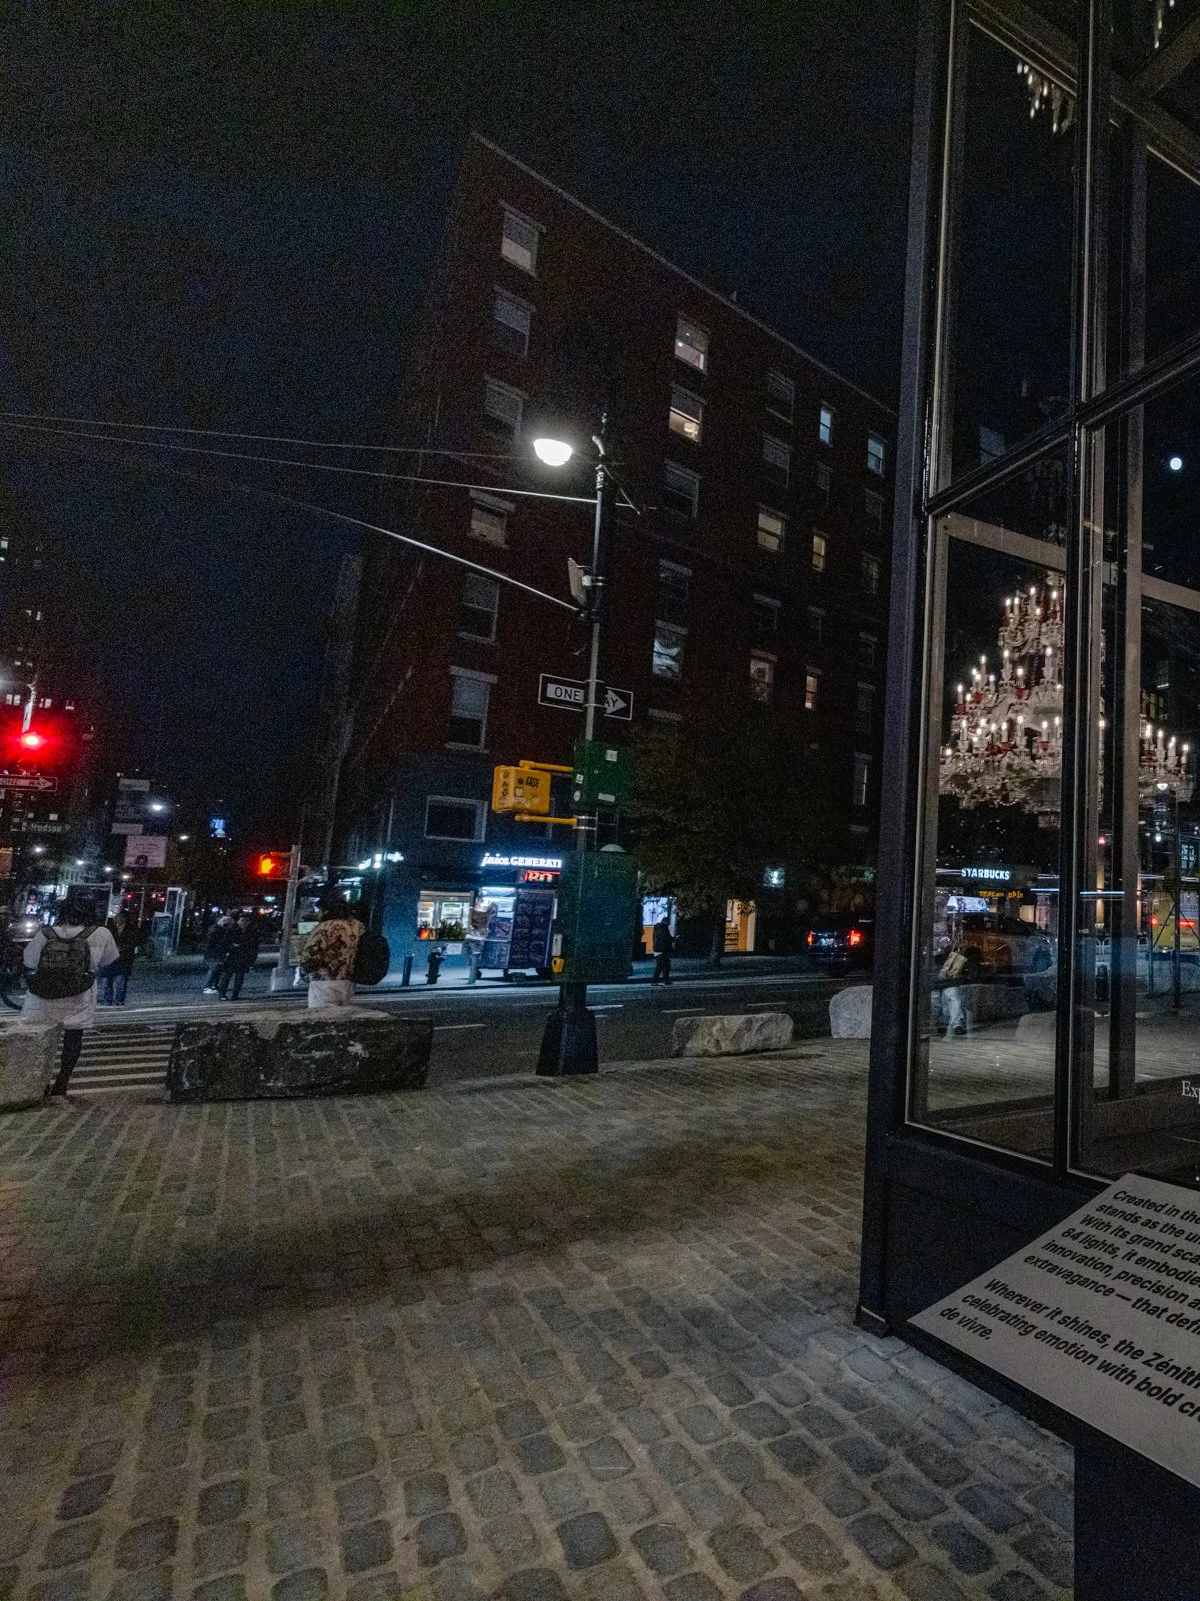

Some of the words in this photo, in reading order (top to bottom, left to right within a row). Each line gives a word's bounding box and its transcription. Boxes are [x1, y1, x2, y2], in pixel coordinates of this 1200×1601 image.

[554, 686, 581, 701] ONE
[31, 823, 62, 832] Hudson
[510, 856, 562, 868] GENERATI
[961, 868, 1011, 880] STARBUCKS
[1096, 1202, 1142, 1224] stands
[1141, 1217, 1160, 1230] as
[1159, 1222, 1185, 1238] the
[1113, 1191, 1165, 1213] Created
[1164, 1204, 1181, 1217] in
[1061, 1227, 1083, 1240] 84
[1079, 1233, 1120, 1259] lights,
[1122, 1249, 1139, 1262] it
[1080, 1214, 1111, 1233] With
[1111, 1225, 1129, 1239] its
[1127, 1233, 1176, 1257] grand
[1024, 1254, 1116, 1297] extravagance
[1131, 1297, 1169, 1319] that
[1041, 1240, 1114, 1277] innovation,
[1114, 1271, 1190, 1304] precision
[939, 1307, 961, 1321] de
[958, 1313, 993, 1341] vivre.
[984, 1278, 1051, 1314] Wherever
[1044, 1306, 1060, 1320] it
[1057, 1311, 1112, 1348] shines,
[1113, 1339, 1145, 1360] the
[961, 1294, 1038, 1336] celebrating
[1034, 1330, 1099, 1366] emotion
[1096, 1359, 1138, 1386] with
[1134, 1377, 1185, 1407] bold
